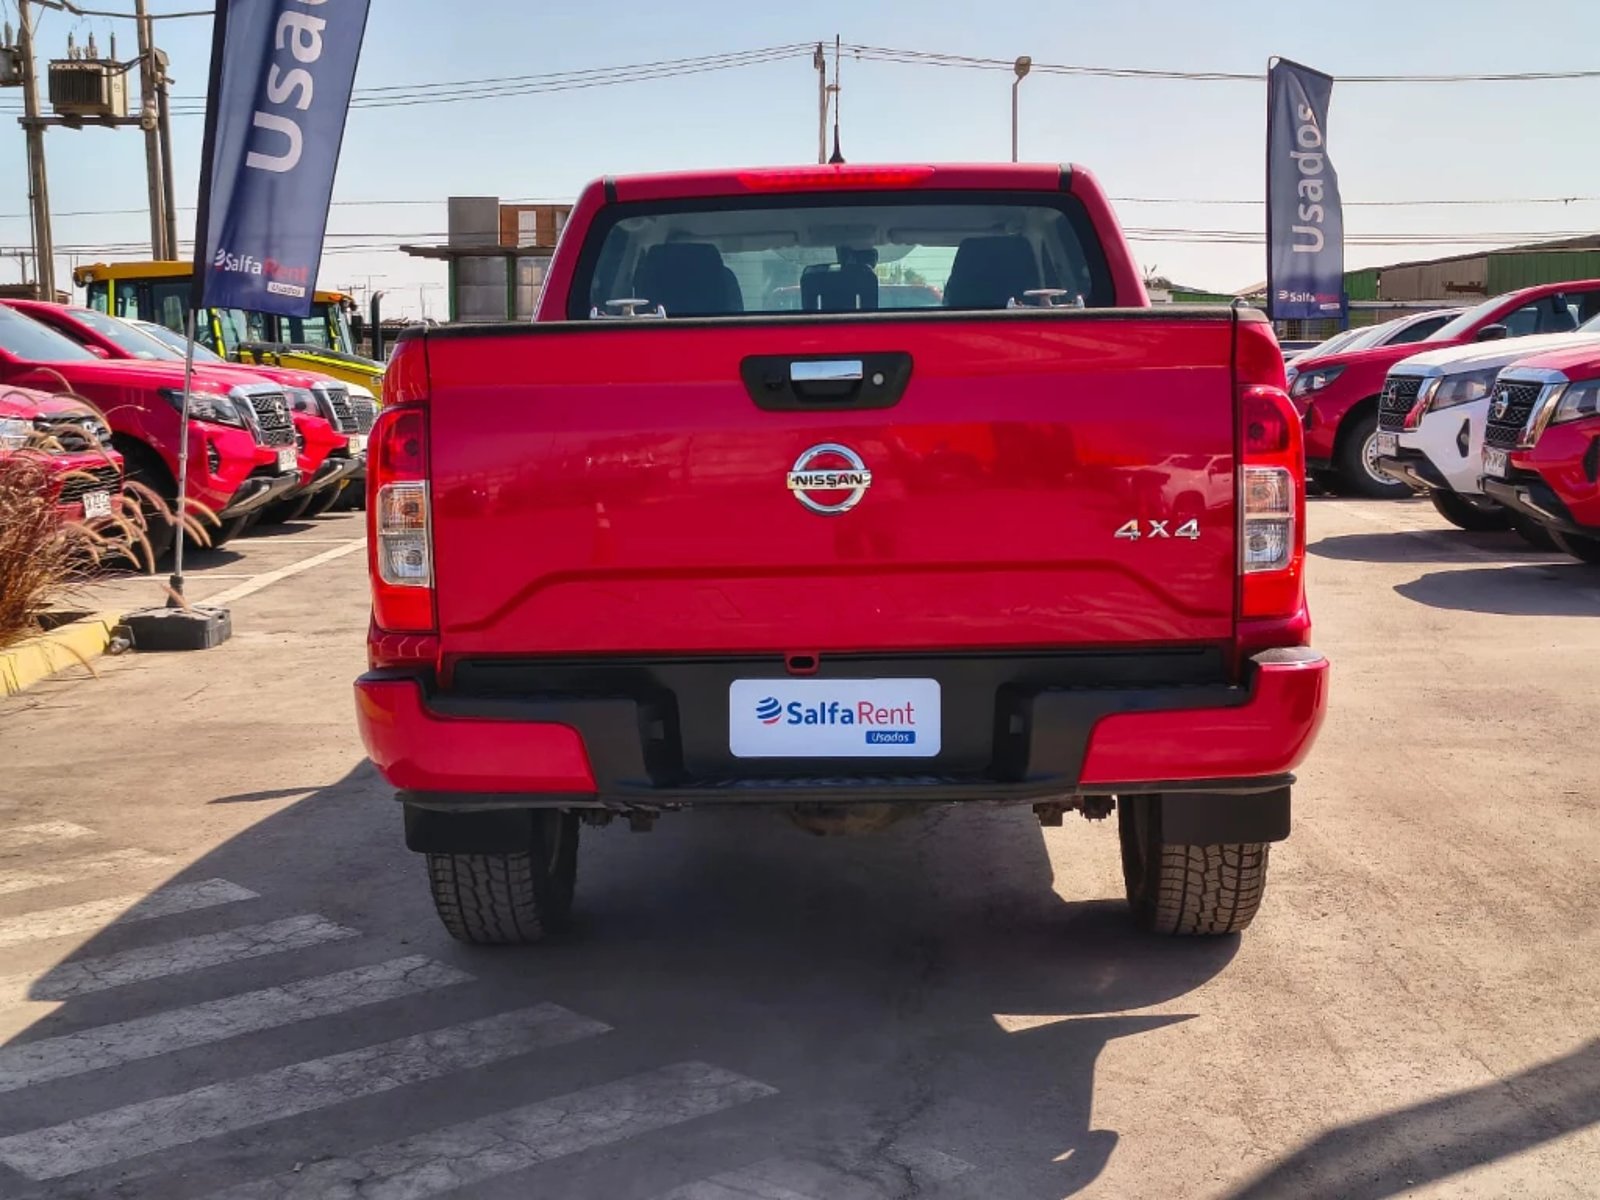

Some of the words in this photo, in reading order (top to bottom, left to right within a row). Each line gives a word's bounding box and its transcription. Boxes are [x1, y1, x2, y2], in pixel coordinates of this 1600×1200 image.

[246, 0, 329, 172] Usa
[1290, 103, 1324, 253] Usados
[1290, 291, 1339, 304] Salfa
[796, 473, 863, 486] NISSAN
[871, 732, 909, 743] Usados
